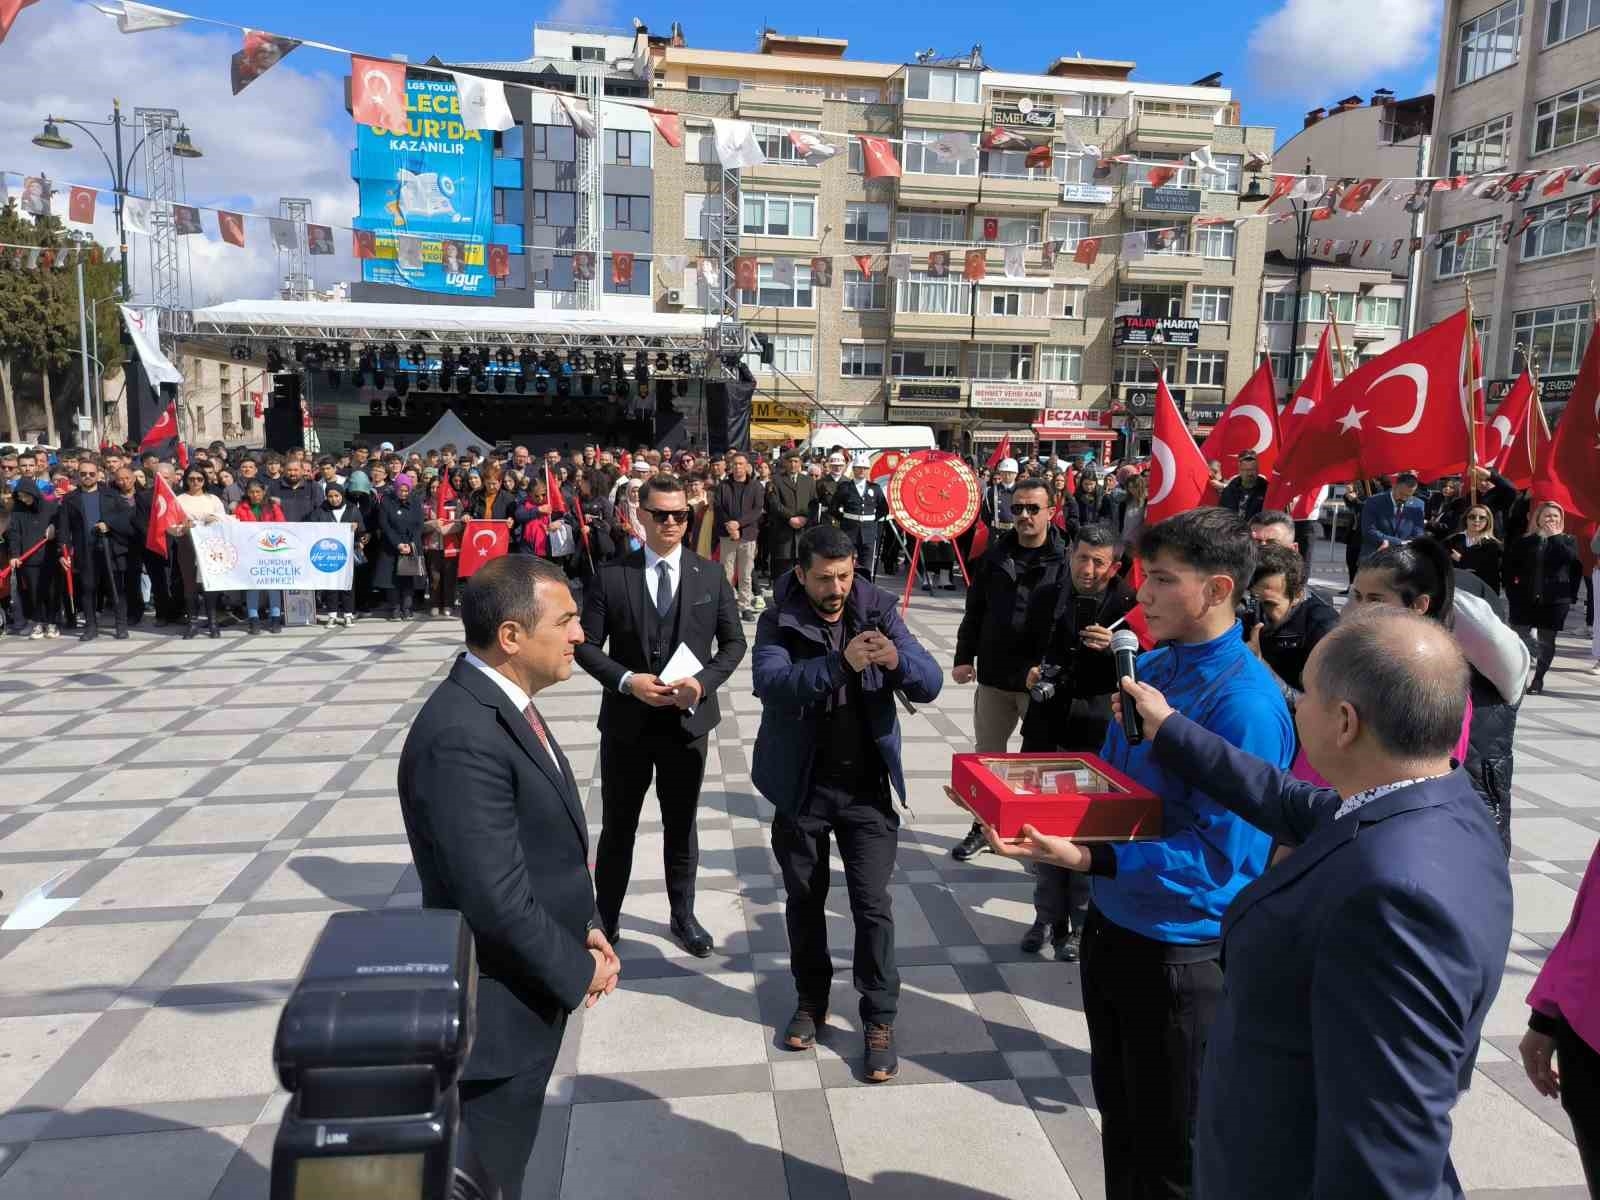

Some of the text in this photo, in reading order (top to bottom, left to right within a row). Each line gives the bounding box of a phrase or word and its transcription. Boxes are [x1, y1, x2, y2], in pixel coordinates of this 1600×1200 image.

[407, 82, 426, 90] LGS
[995, 111, 1025, 124] EMEL
[371, 118, 482, 141] UR'DA
[390, 139, 465, 154] KAZANILIR
[1126, 318, 1157, 328] TALAY
[1047, 410, 1099, 422] ECZANE
[326, 1133, 348, 1144] LINK
